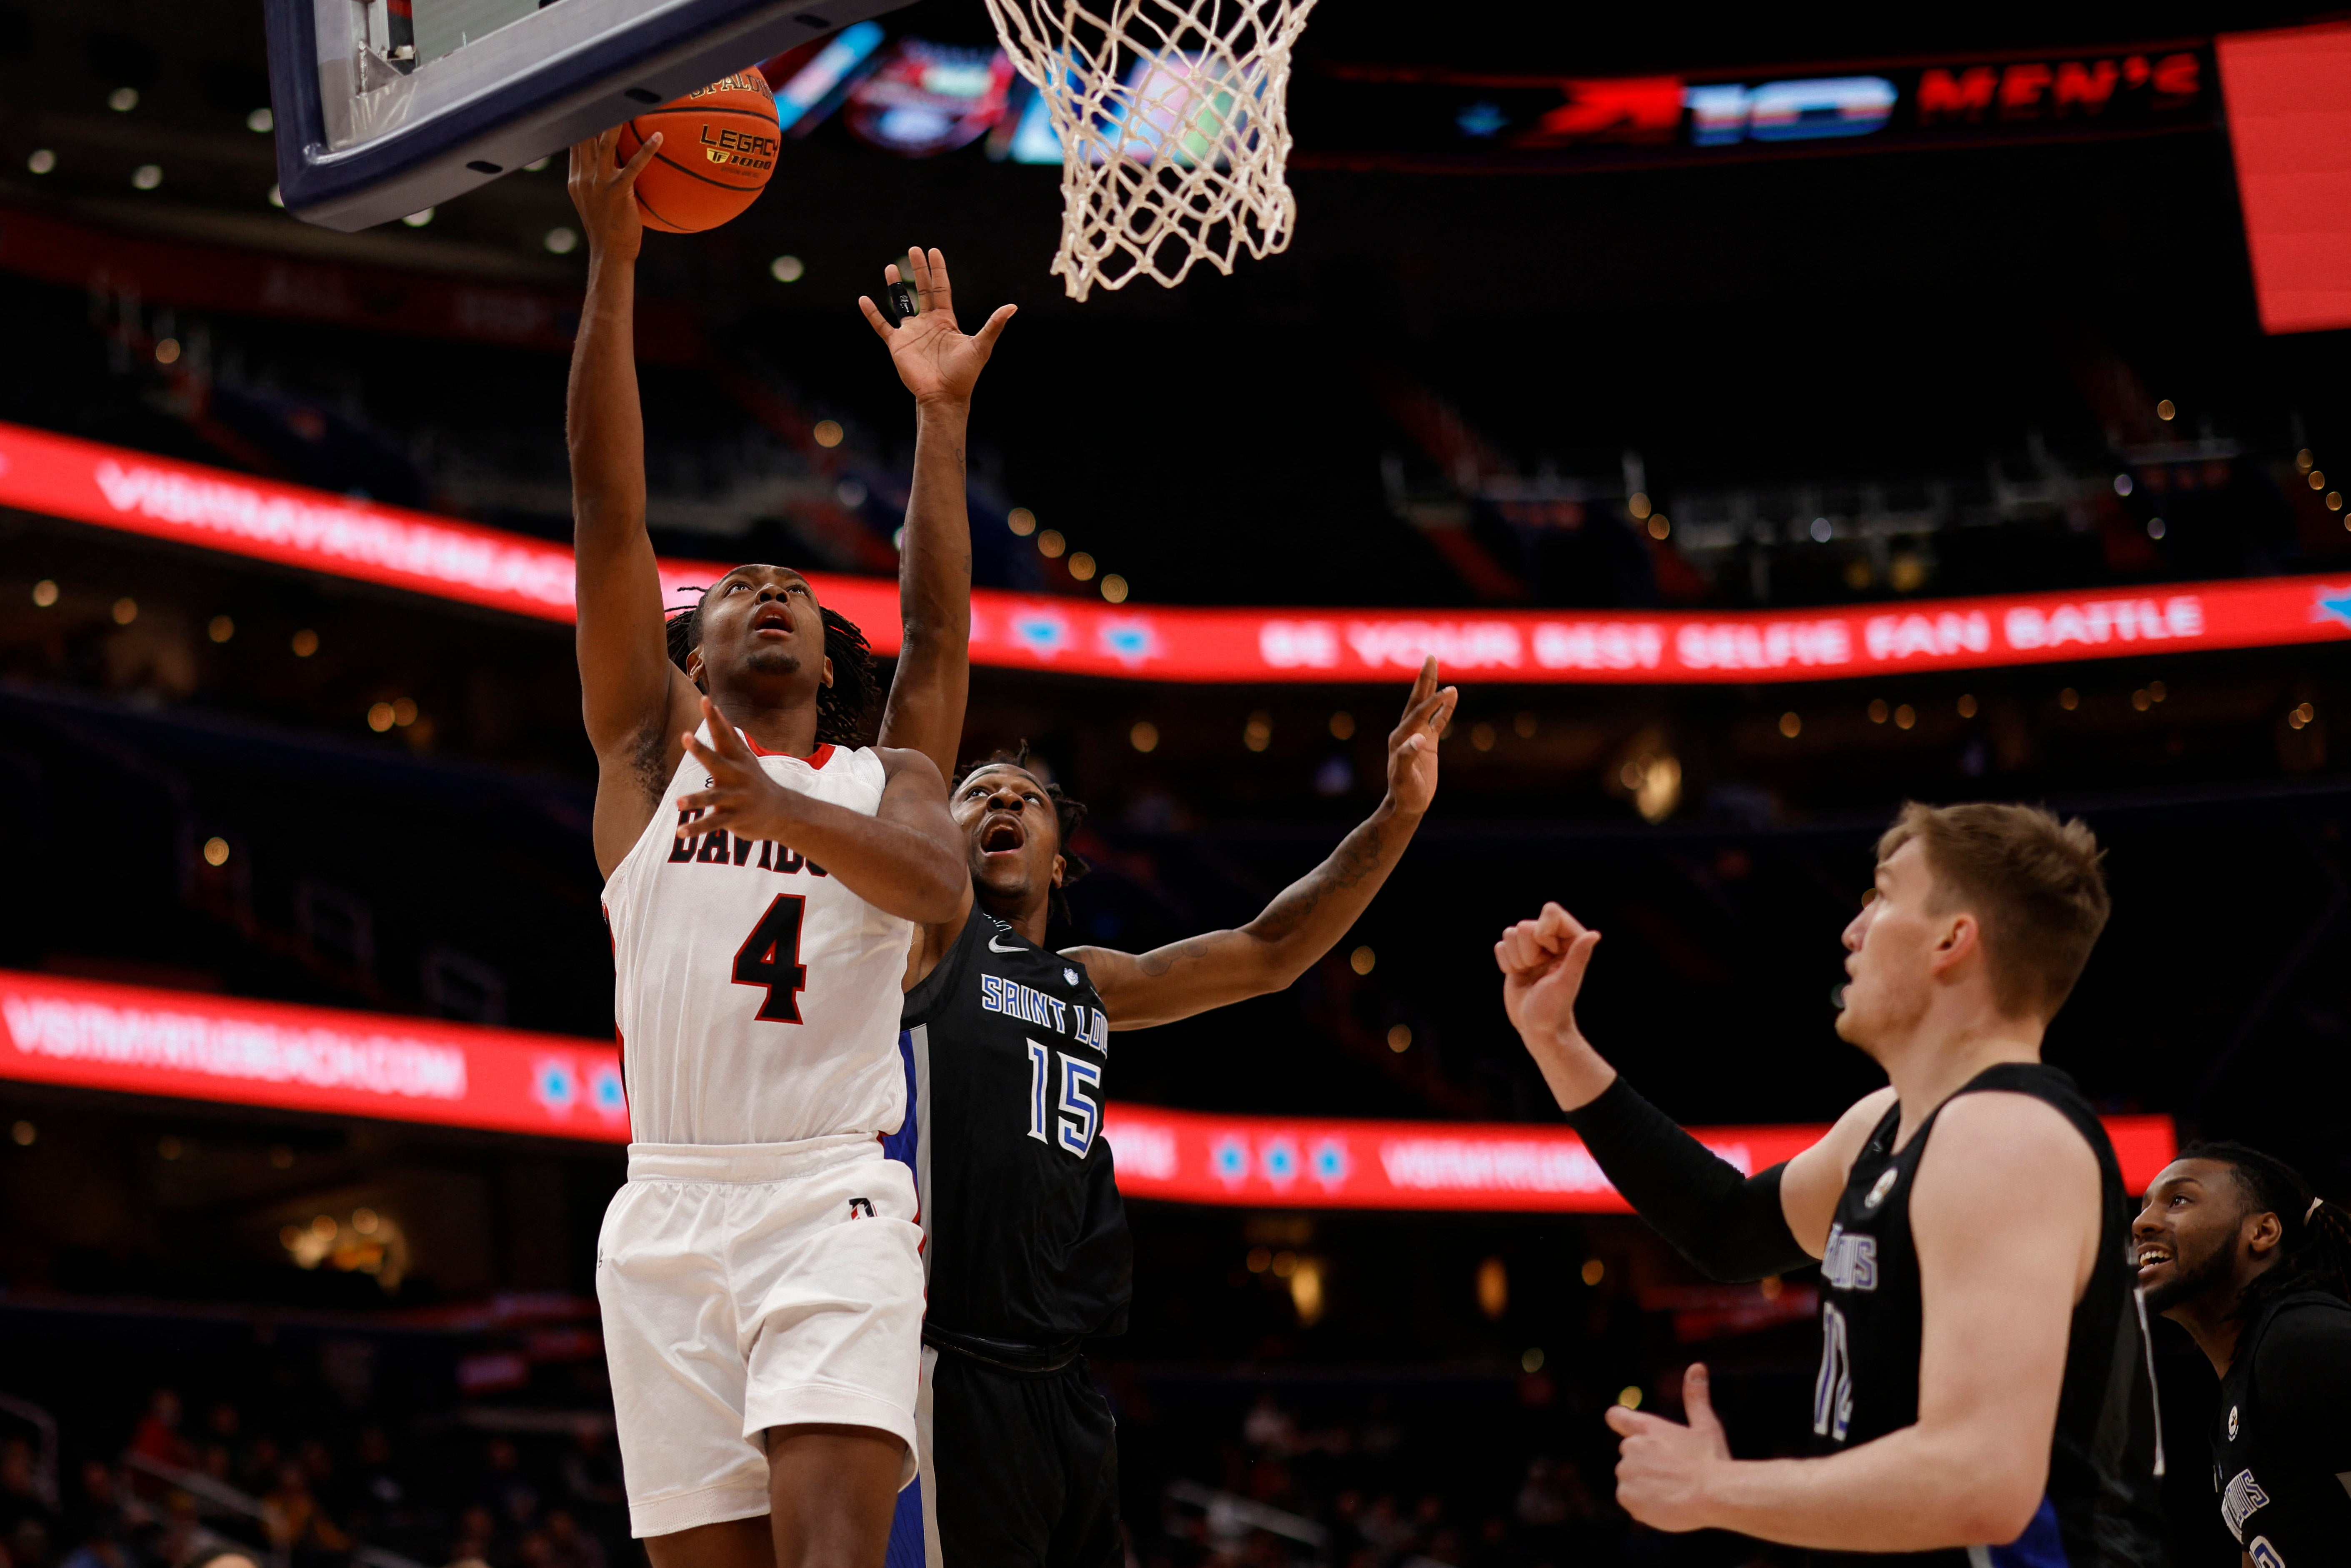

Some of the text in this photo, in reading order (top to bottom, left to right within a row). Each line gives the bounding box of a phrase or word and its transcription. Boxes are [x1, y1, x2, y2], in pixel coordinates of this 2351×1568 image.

[1918, 51, 2201, 125] MEN'S
[700, 124, 780, 157] LEGACY
[730, 155, 772, 170] 1000
[1257, 594, 2203, 669] BE YOUR BEST SELFIE FAN BATTLE
[731, 893, 807, 1025] 4
[981, 973, 1066, 1034] SAINT
[1026, 1037, 1101, 1159] 15
